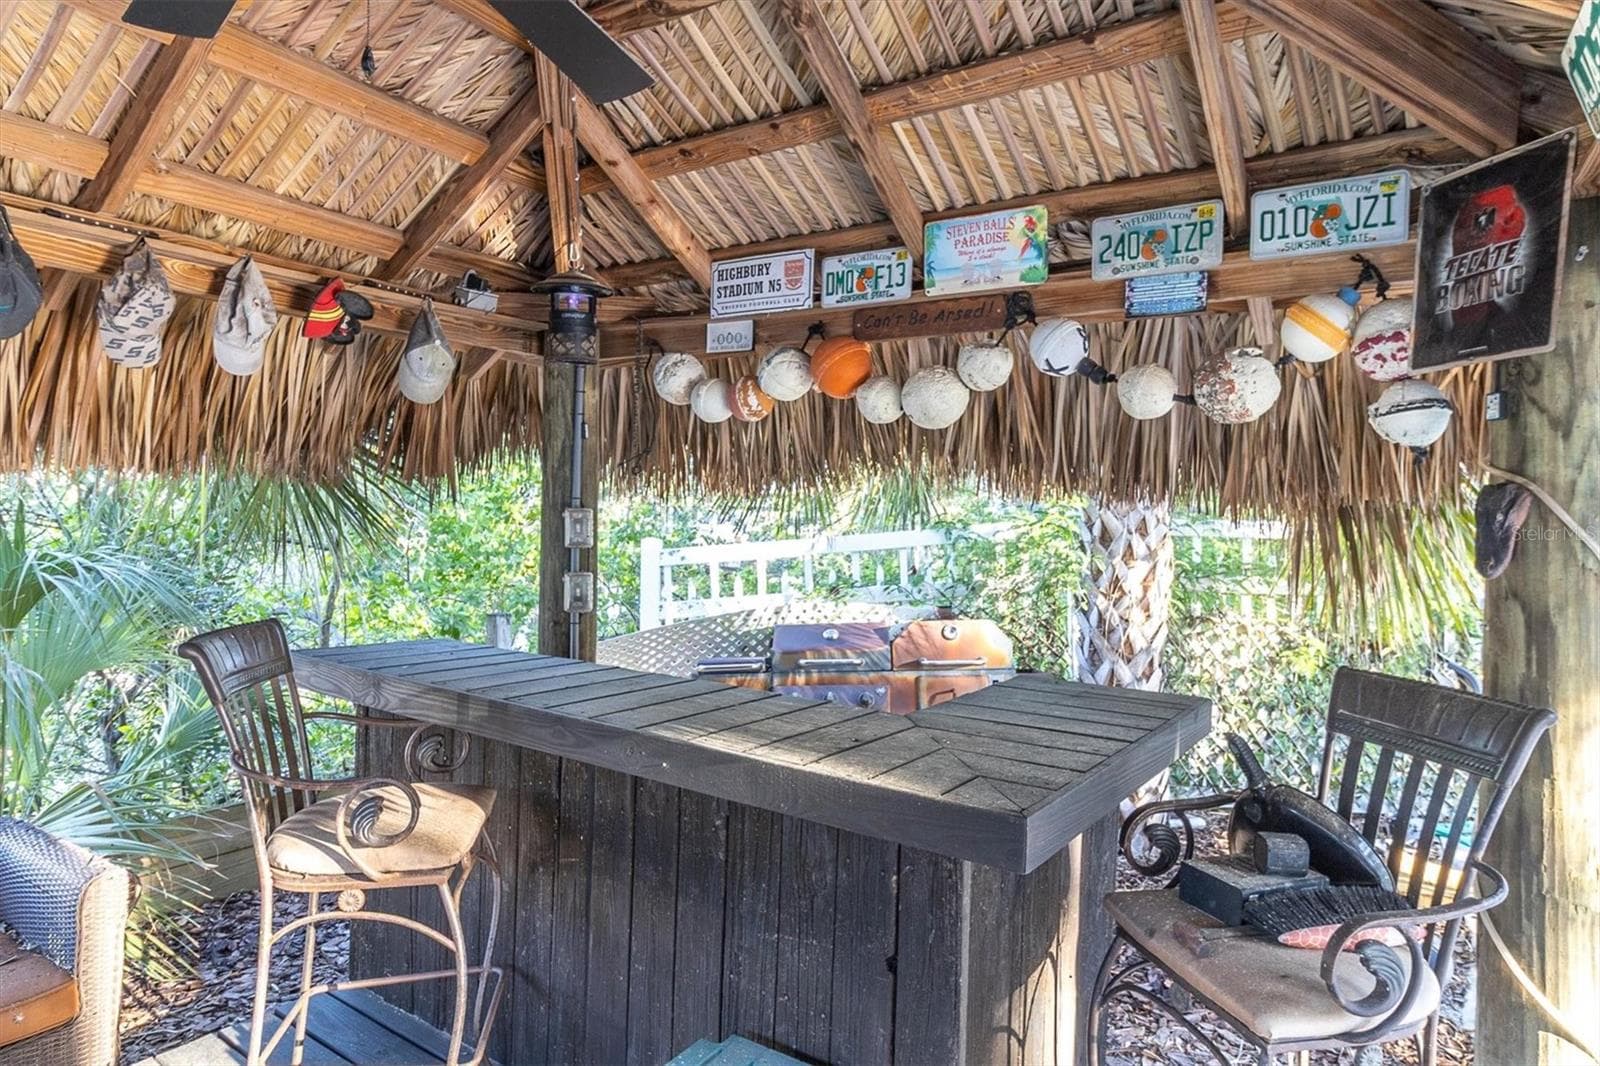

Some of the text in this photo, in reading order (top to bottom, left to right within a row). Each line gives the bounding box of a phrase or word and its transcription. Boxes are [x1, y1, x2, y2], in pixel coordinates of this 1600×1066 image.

[1285, 183, 1373, 206] MYFLORIDA.COM
[1119, 211, 1193, 229] MYFLORIDA.COM
[1259, 192, 1397, 242] 010 JZI
[946, 221, 982, 240] STEVEN
[954, 231, 1010, 249] PARADISE
[1171, 220, 1214, 254] IZP
[1284, 234, 1369, 252] SUNSHINE STATE
[1119, 257, 1191, 273] SUNSHINE STATE
[1443, 238, 1522, 281] TECATE
[717, 262, 772, 282] HIGHBURY
[875, 262, 905, 290] F13
[716, 279, 782, 299] STADIUM N5
[1435, 264, 1526, 314] BOXING
[863, 301, 995, 330] Can't Be Arsed!
